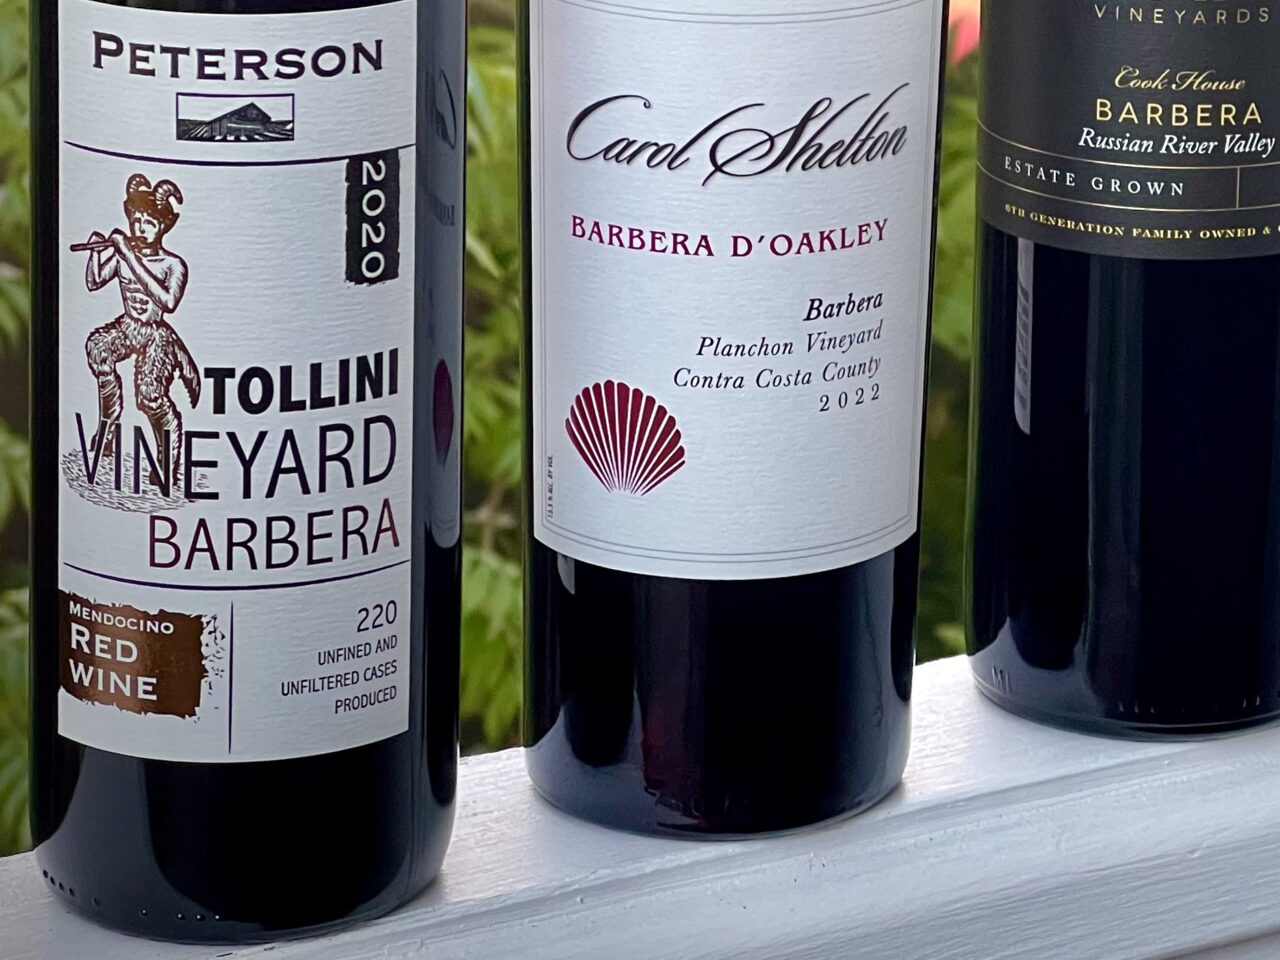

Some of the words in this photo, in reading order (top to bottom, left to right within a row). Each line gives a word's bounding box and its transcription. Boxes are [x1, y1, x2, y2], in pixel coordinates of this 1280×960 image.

[1094, 3, 1270, 25] VINEYARDS
[92, 30, 384, 82] PETERSON
[1114, 65, 1170, 90] Cook
[1170, 69, 1247, 91] House
[1096, 98, 1262, 127] BARBERA
[566, 93, 765, 172] Carol
[701, 81, 910, 187] Shelton
[1078, 127, 1153, 154] Russian
[1160, 134, 1218, 155] River
[1223, 132, 1276, 158] Valley
[1004, 155, 1076, 187] ESTATE
[1091, 176, 1184, 196] GROWN
[361, 159, 387, 280] 2020
[571, 214, 714, 258] BARBERA
[1030, 211, 1125, 236] GENERATION
[1132, 227, 1192, 239] FAMILY
[1199, 226, 1256, 239] OWNED
[1262, 225, 1272, 235] &
[803, 290, 883, 322] Barbera
[696, 336, 794, 358] Planchon
[806, 319, 884, 354] Vineyard
[204, 347, 399, 415] TOLLINI
[674, 367, 745, 390] Contra
[755, 368, 812, 389] Costa
[822, 354, 882, 384] County
[819, 383, 880, 412] 2022
[75, 412, 397, 501] VINEYARD
[148, 497, 400, 571] BARBERA
[69, 600, 174, 635] MENDOCINO
[356, 600, 397, 633] 220
[70, 622, 138, 664] RED
[317, 642, 372, 667] UNFINED
[374, 635, 398, 656] AND
[69, 658, 158, 701] WINE
[281, 672, 360, 697] UNFILTERED
[363, 660, 398, 682] CASES
[334, 685, 398, 714] PRODUCED
